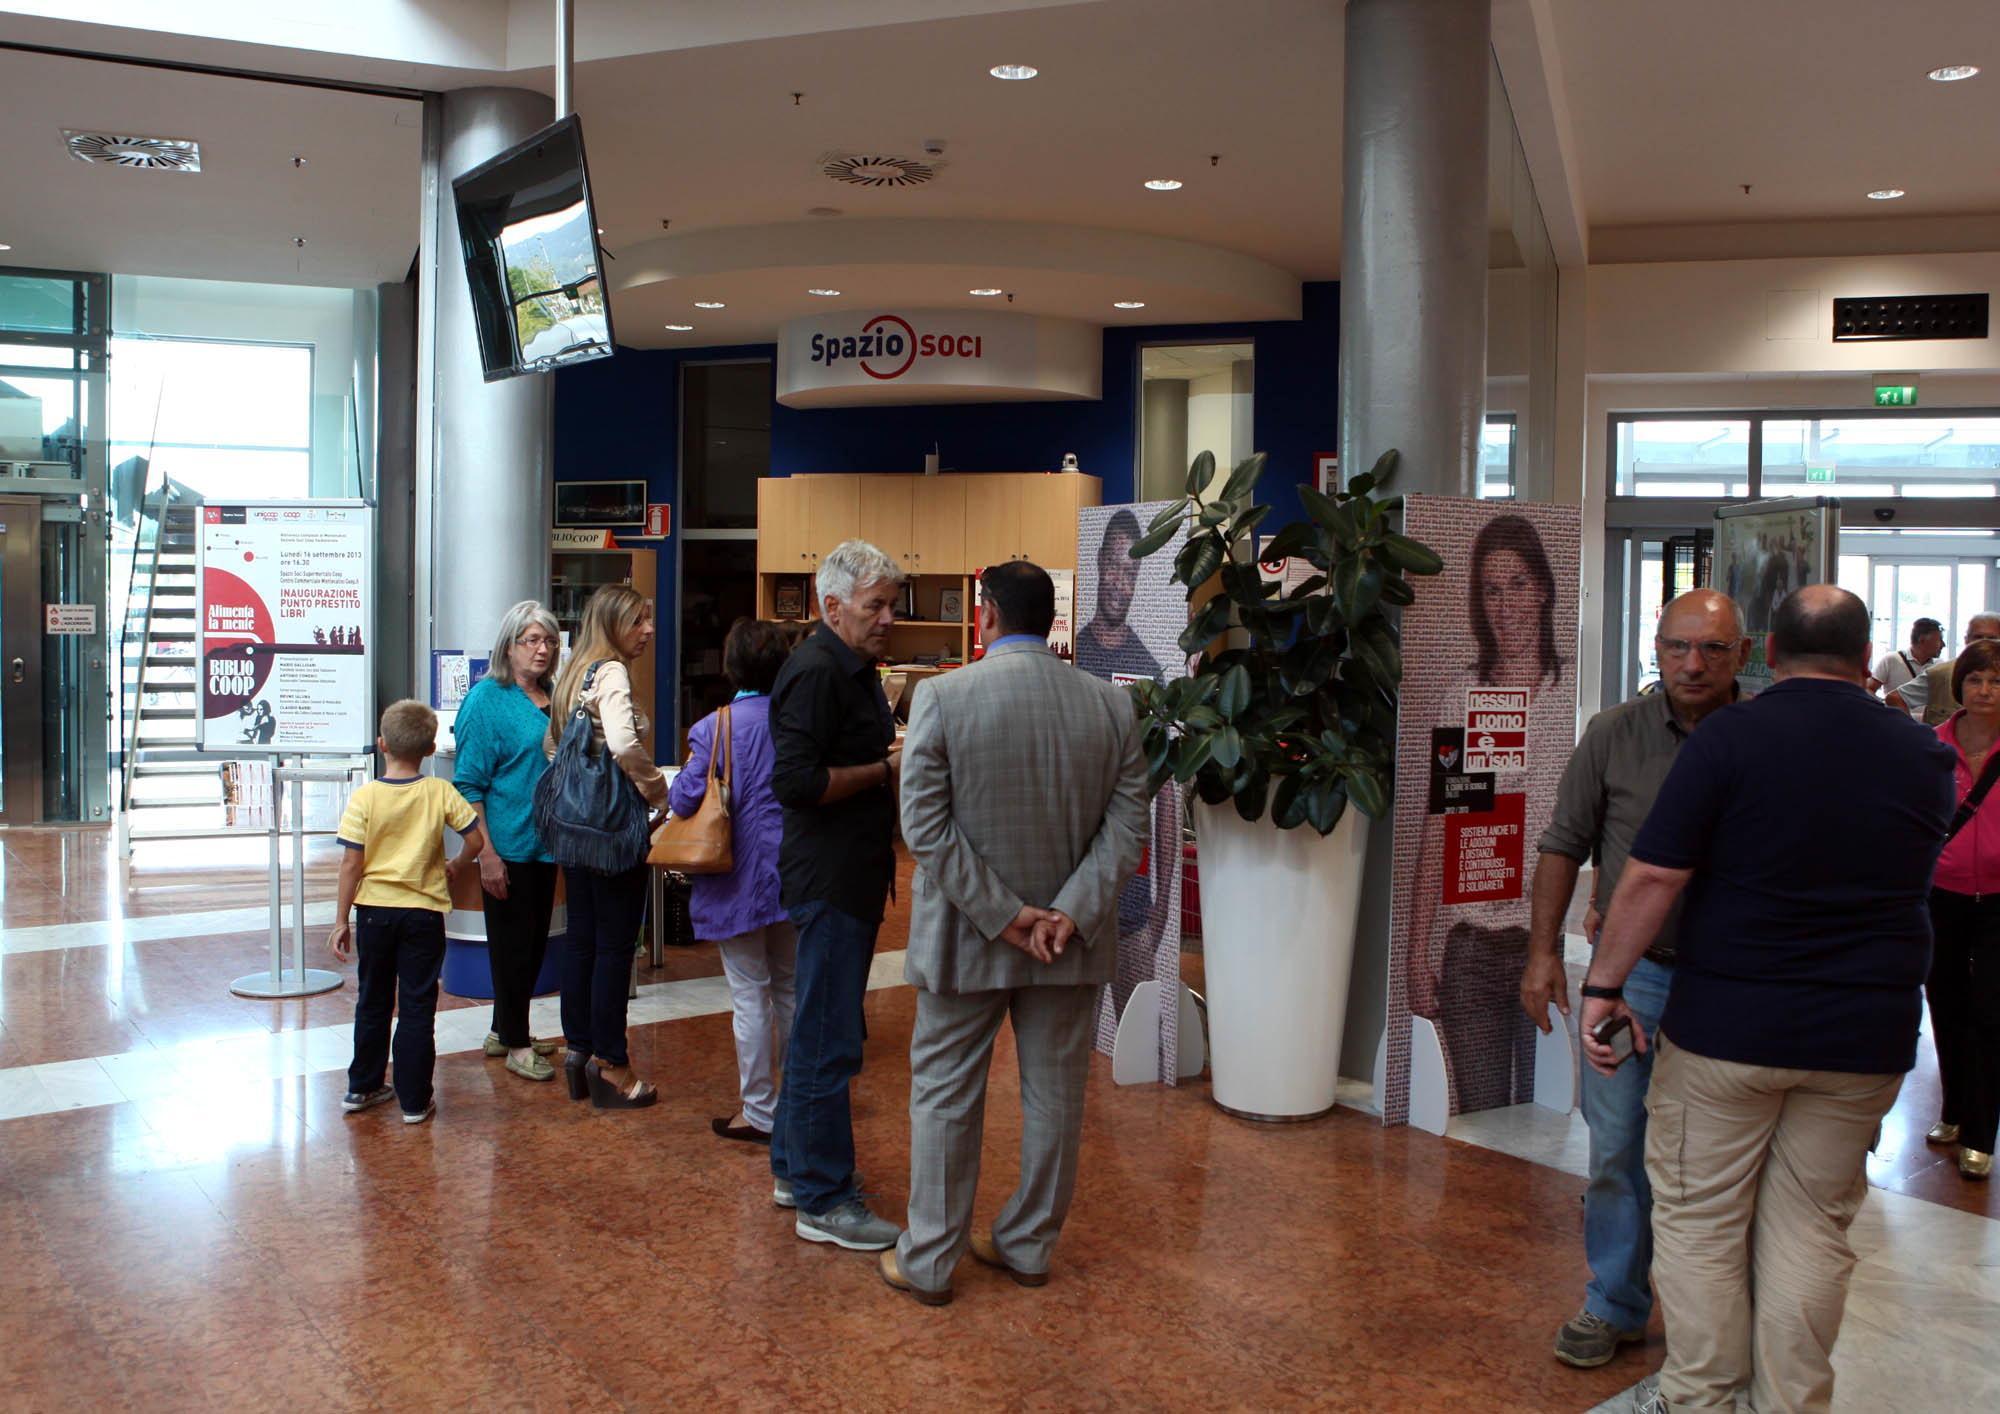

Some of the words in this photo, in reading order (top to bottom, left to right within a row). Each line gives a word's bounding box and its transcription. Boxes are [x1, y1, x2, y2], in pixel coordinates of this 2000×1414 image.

[811, 326, 904, 367] Spazio
[280, 588, 358, 598] INAUGURAZIONE
[280, 598, 313, 608] PUNTO
[314, 599, 361, 609] PRESTITO
[208, 604, 255, 618] Alimenta
[280, 608, 306, 618] LIBRI
[208, 616, 219, 630] la
[222, 617, 255, 631] mente
[209, 659, 255, 676] BIBLIO
[209, 675, 255, 696] COOP
[1470, 693, 1524, 708] nessun
[1475, 714, 1523, 728] uomo
[1477, 731, 1496, 748] è
[1467, 751, 1522, 768] un'isola
[1488, 825, 1509, 836] ANCHE
[1510, 824, 1518, 835] TU
[1460, 838, 1468, 849] LE
[1459, 849, 1465, 860] A
[1465, 847, 1495, 859] DISTANZA
[1459, 860, 1464, 871] E
